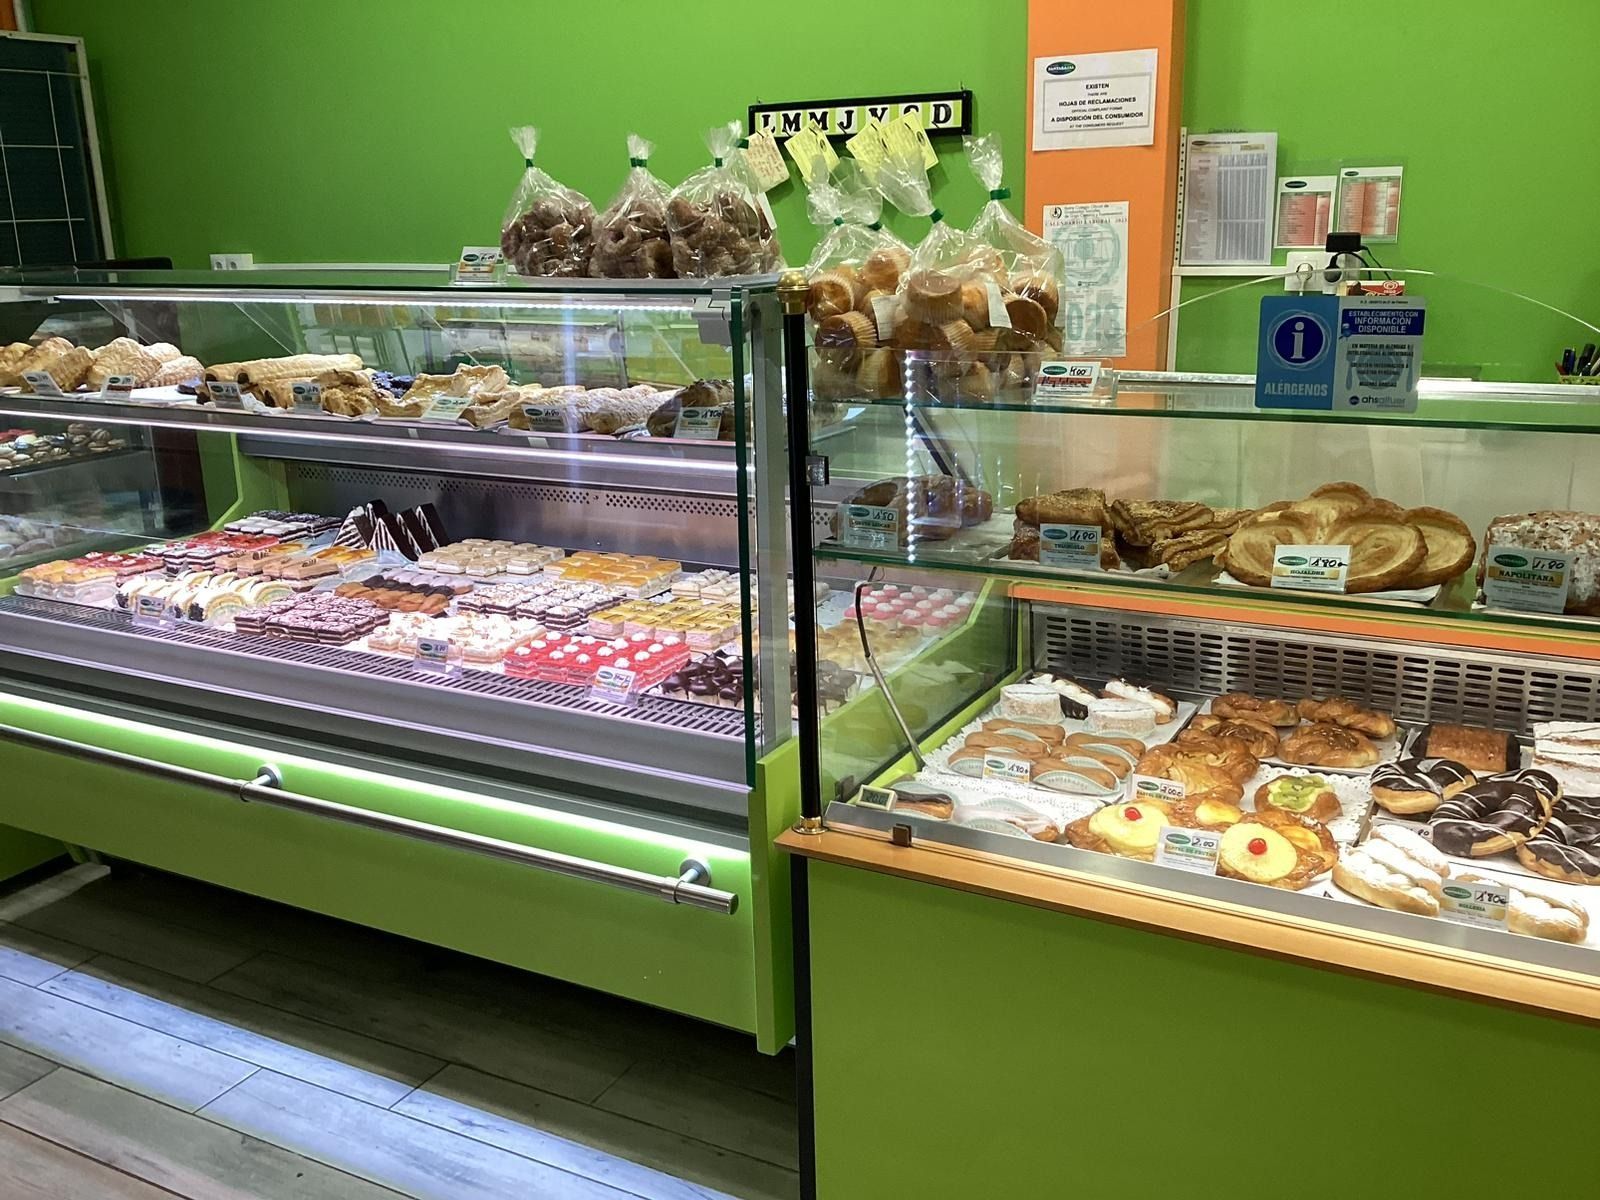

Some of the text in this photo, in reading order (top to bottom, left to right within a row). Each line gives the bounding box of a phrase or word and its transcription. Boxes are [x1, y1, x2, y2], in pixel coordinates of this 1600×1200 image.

[1088, 97, 1136, 105] RECLAMACIONES
[782, 113, 801, 132] M
[809, 111, 829, 131] M
[840, 110, 854, 130] J
[932, 104, 952, 124] D
[1358, 325, 1407, 333] DISPONIBLE
[1264, 379, 1328, 397] ALÉRGENOS
[1498, 570, 1554, 582] NAPOLITANA
